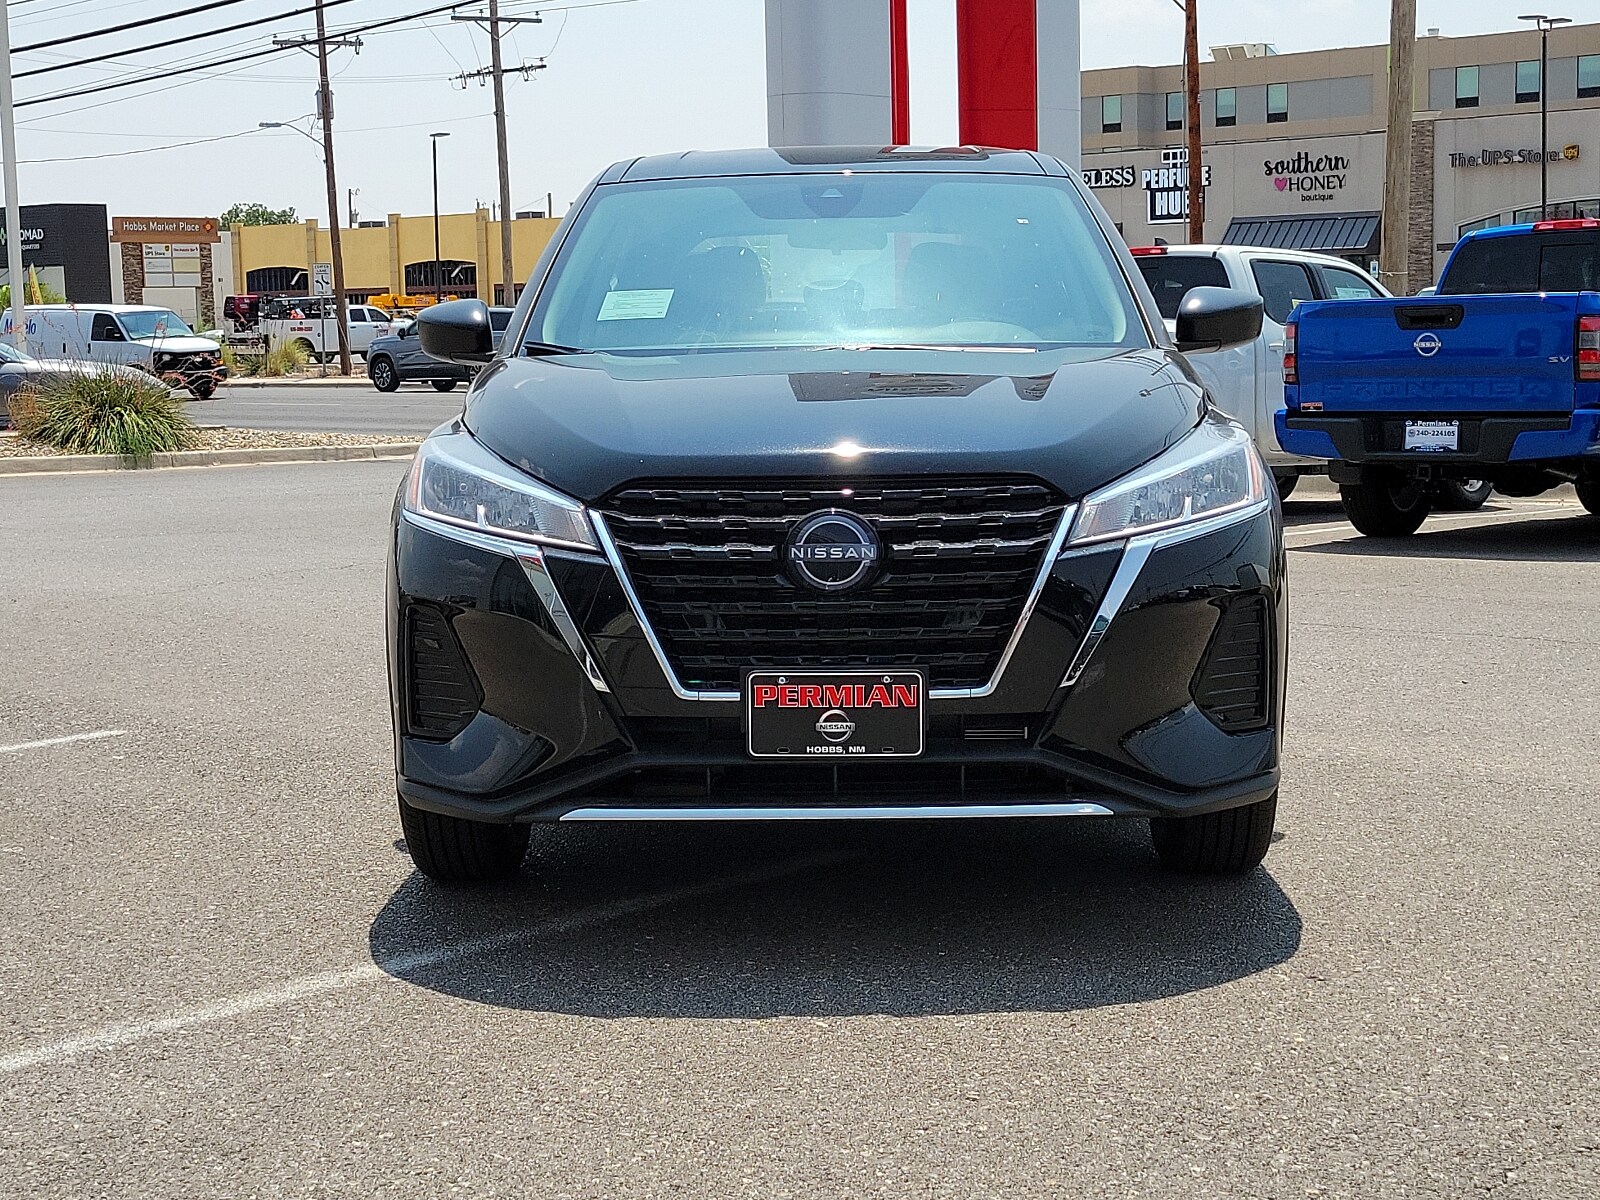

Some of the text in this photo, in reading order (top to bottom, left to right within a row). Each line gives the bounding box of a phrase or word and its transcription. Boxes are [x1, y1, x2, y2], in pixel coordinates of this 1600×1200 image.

[1263, 151, 1350, 176] southern
[1448, 152, 1478, 168] The
[1481, 149, 1516, 166] UPS
[1081, 167, 1135, 188] ELESS
[1141, 165, 1211, 190] PERFUE
[1288, 174, 1347, 192] HONEY
[1300, 193, 1334, 202] boutique
[123, 221, 200, 232] Hobbs Market Place
[19, 228, 45, 241] OMAD
[791, 547, 875, 559] NISSAN
[754, 684, 918, 708] PERMIAN
[818, 723, 853, 731] NISSAN
[806, 745, 866, 755] HOBBS, NM
